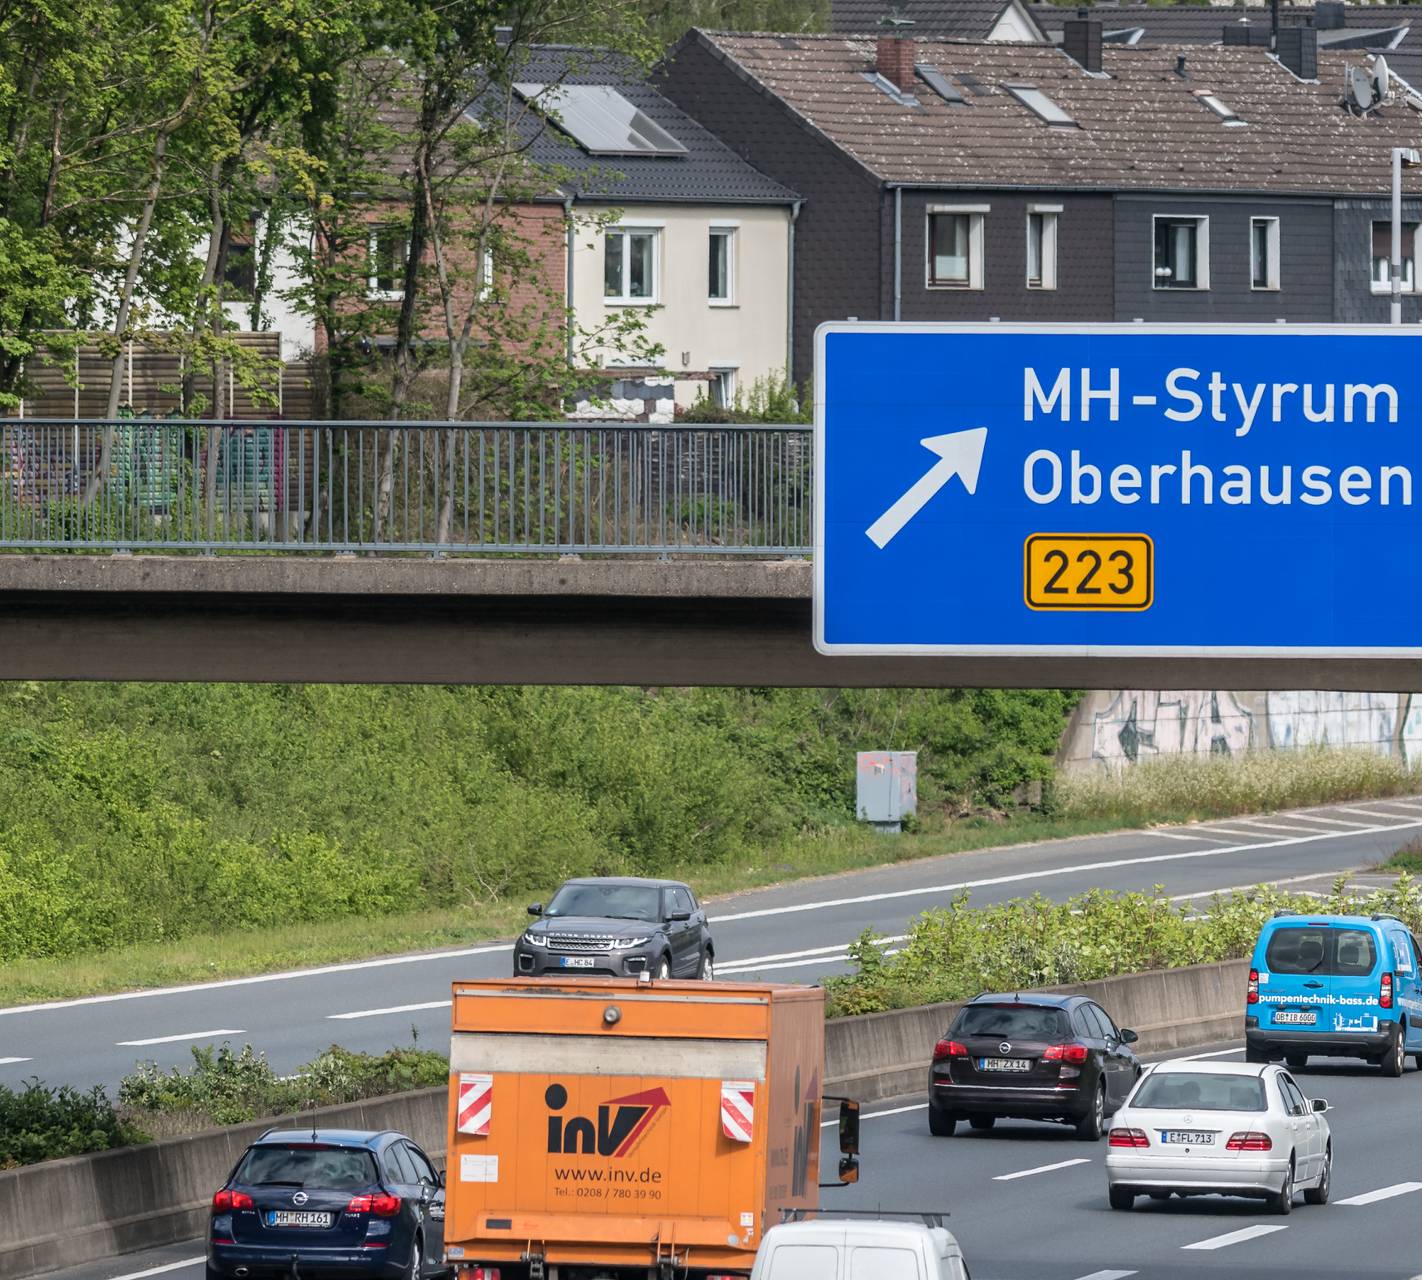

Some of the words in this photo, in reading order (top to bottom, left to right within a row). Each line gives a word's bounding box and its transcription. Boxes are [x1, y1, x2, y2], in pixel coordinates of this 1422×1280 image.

[1024, 368, 1398, 437] MH-Styrum
[1024, 449, 1412, 505] Oberhausen
[1043, 550, 1134, 594] 223
[1258, 994, 1379, 1006] pumpentechnik-bass.de
[1016, 1059, 1026, 1068] 14
[1181, 1133, 1193, 1143] FL
[1195, 1133, 1212, 1143] 713
[555, 1166, 662, 1183] www.inv.de
[576, 1187, 602, 1198] 0208
[613, 1188, 631, 1199] 780
[275, 1212, 289, 1223] MH
[295, 1213, 310, 1224] RH
[310, 1213, 329, 1224] 161
